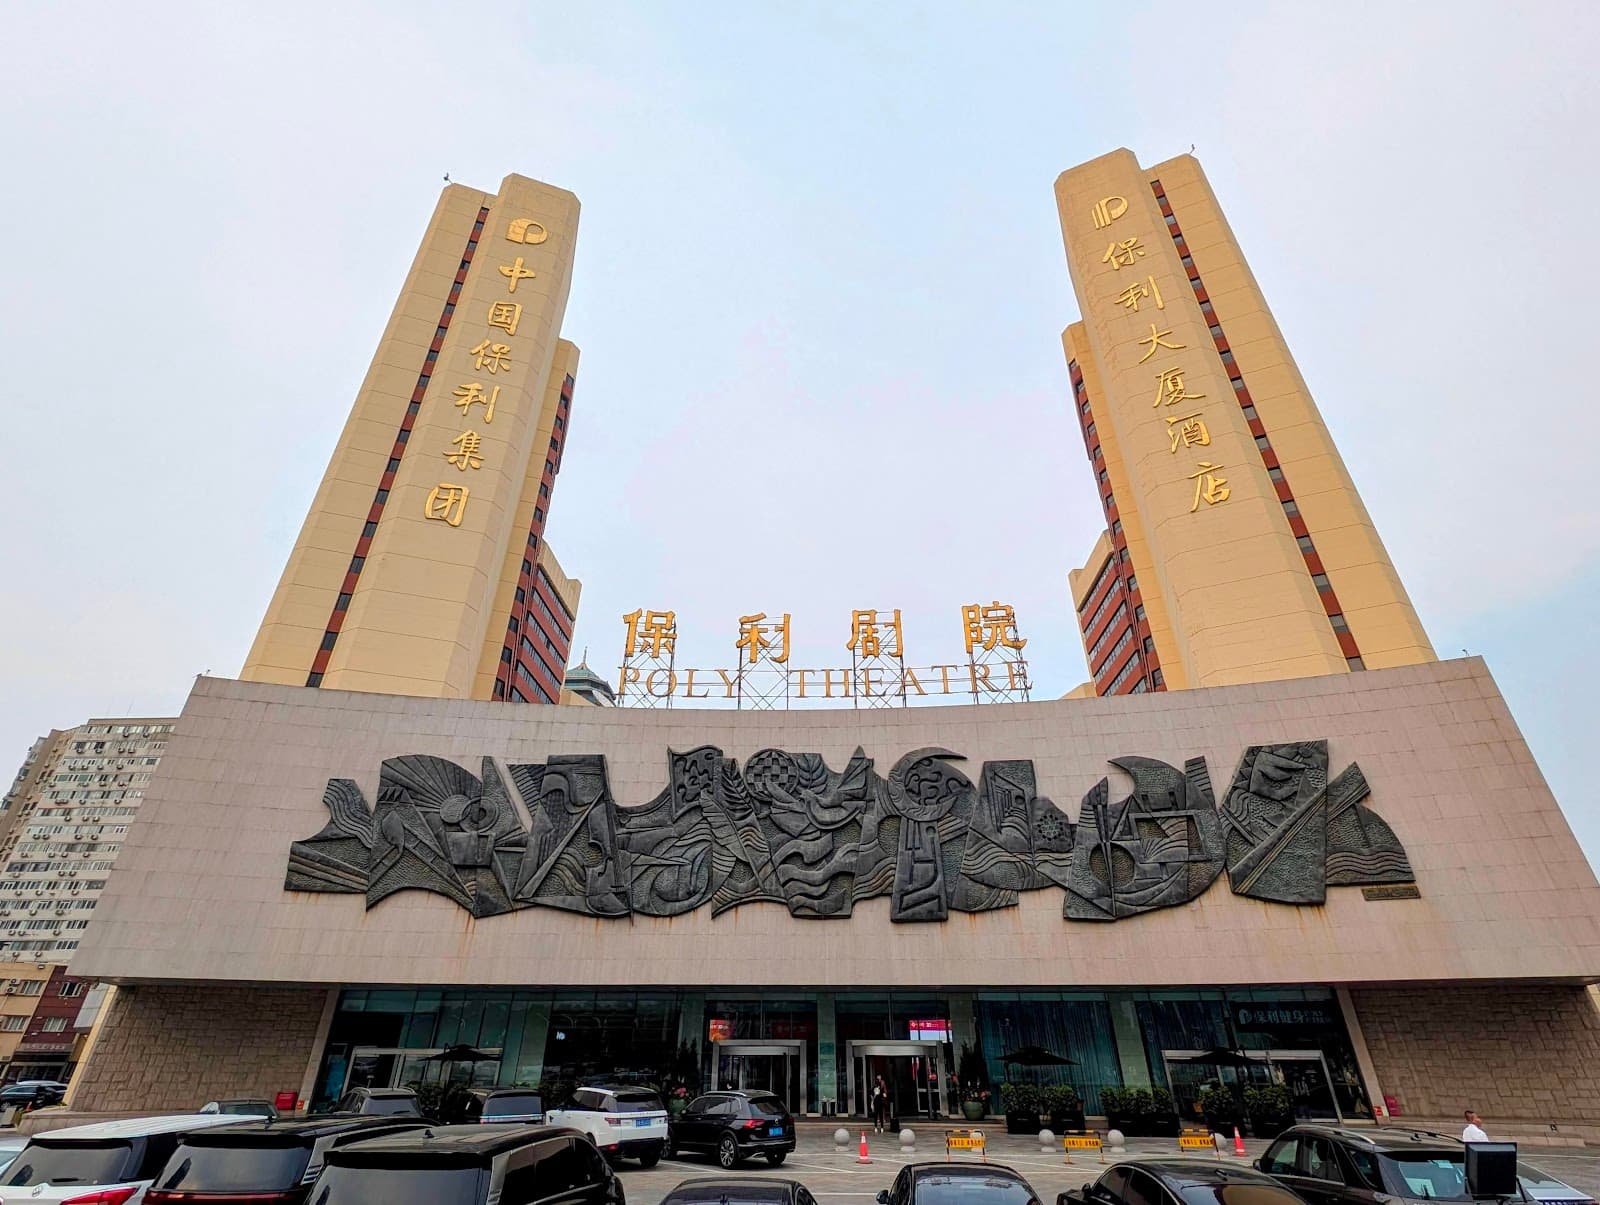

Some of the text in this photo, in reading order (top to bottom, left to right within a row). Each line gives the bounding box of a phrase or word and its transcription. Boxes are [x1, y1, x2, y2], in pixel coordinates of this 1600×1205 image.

[424, 256, 536, 527] 中国保利集团
[1102, 237, 1231, 513] 保利大厦酒店
[616, 660, 1033, 698] POLY THEATRE
[622, 601, 1028, 664] 保利剧院
